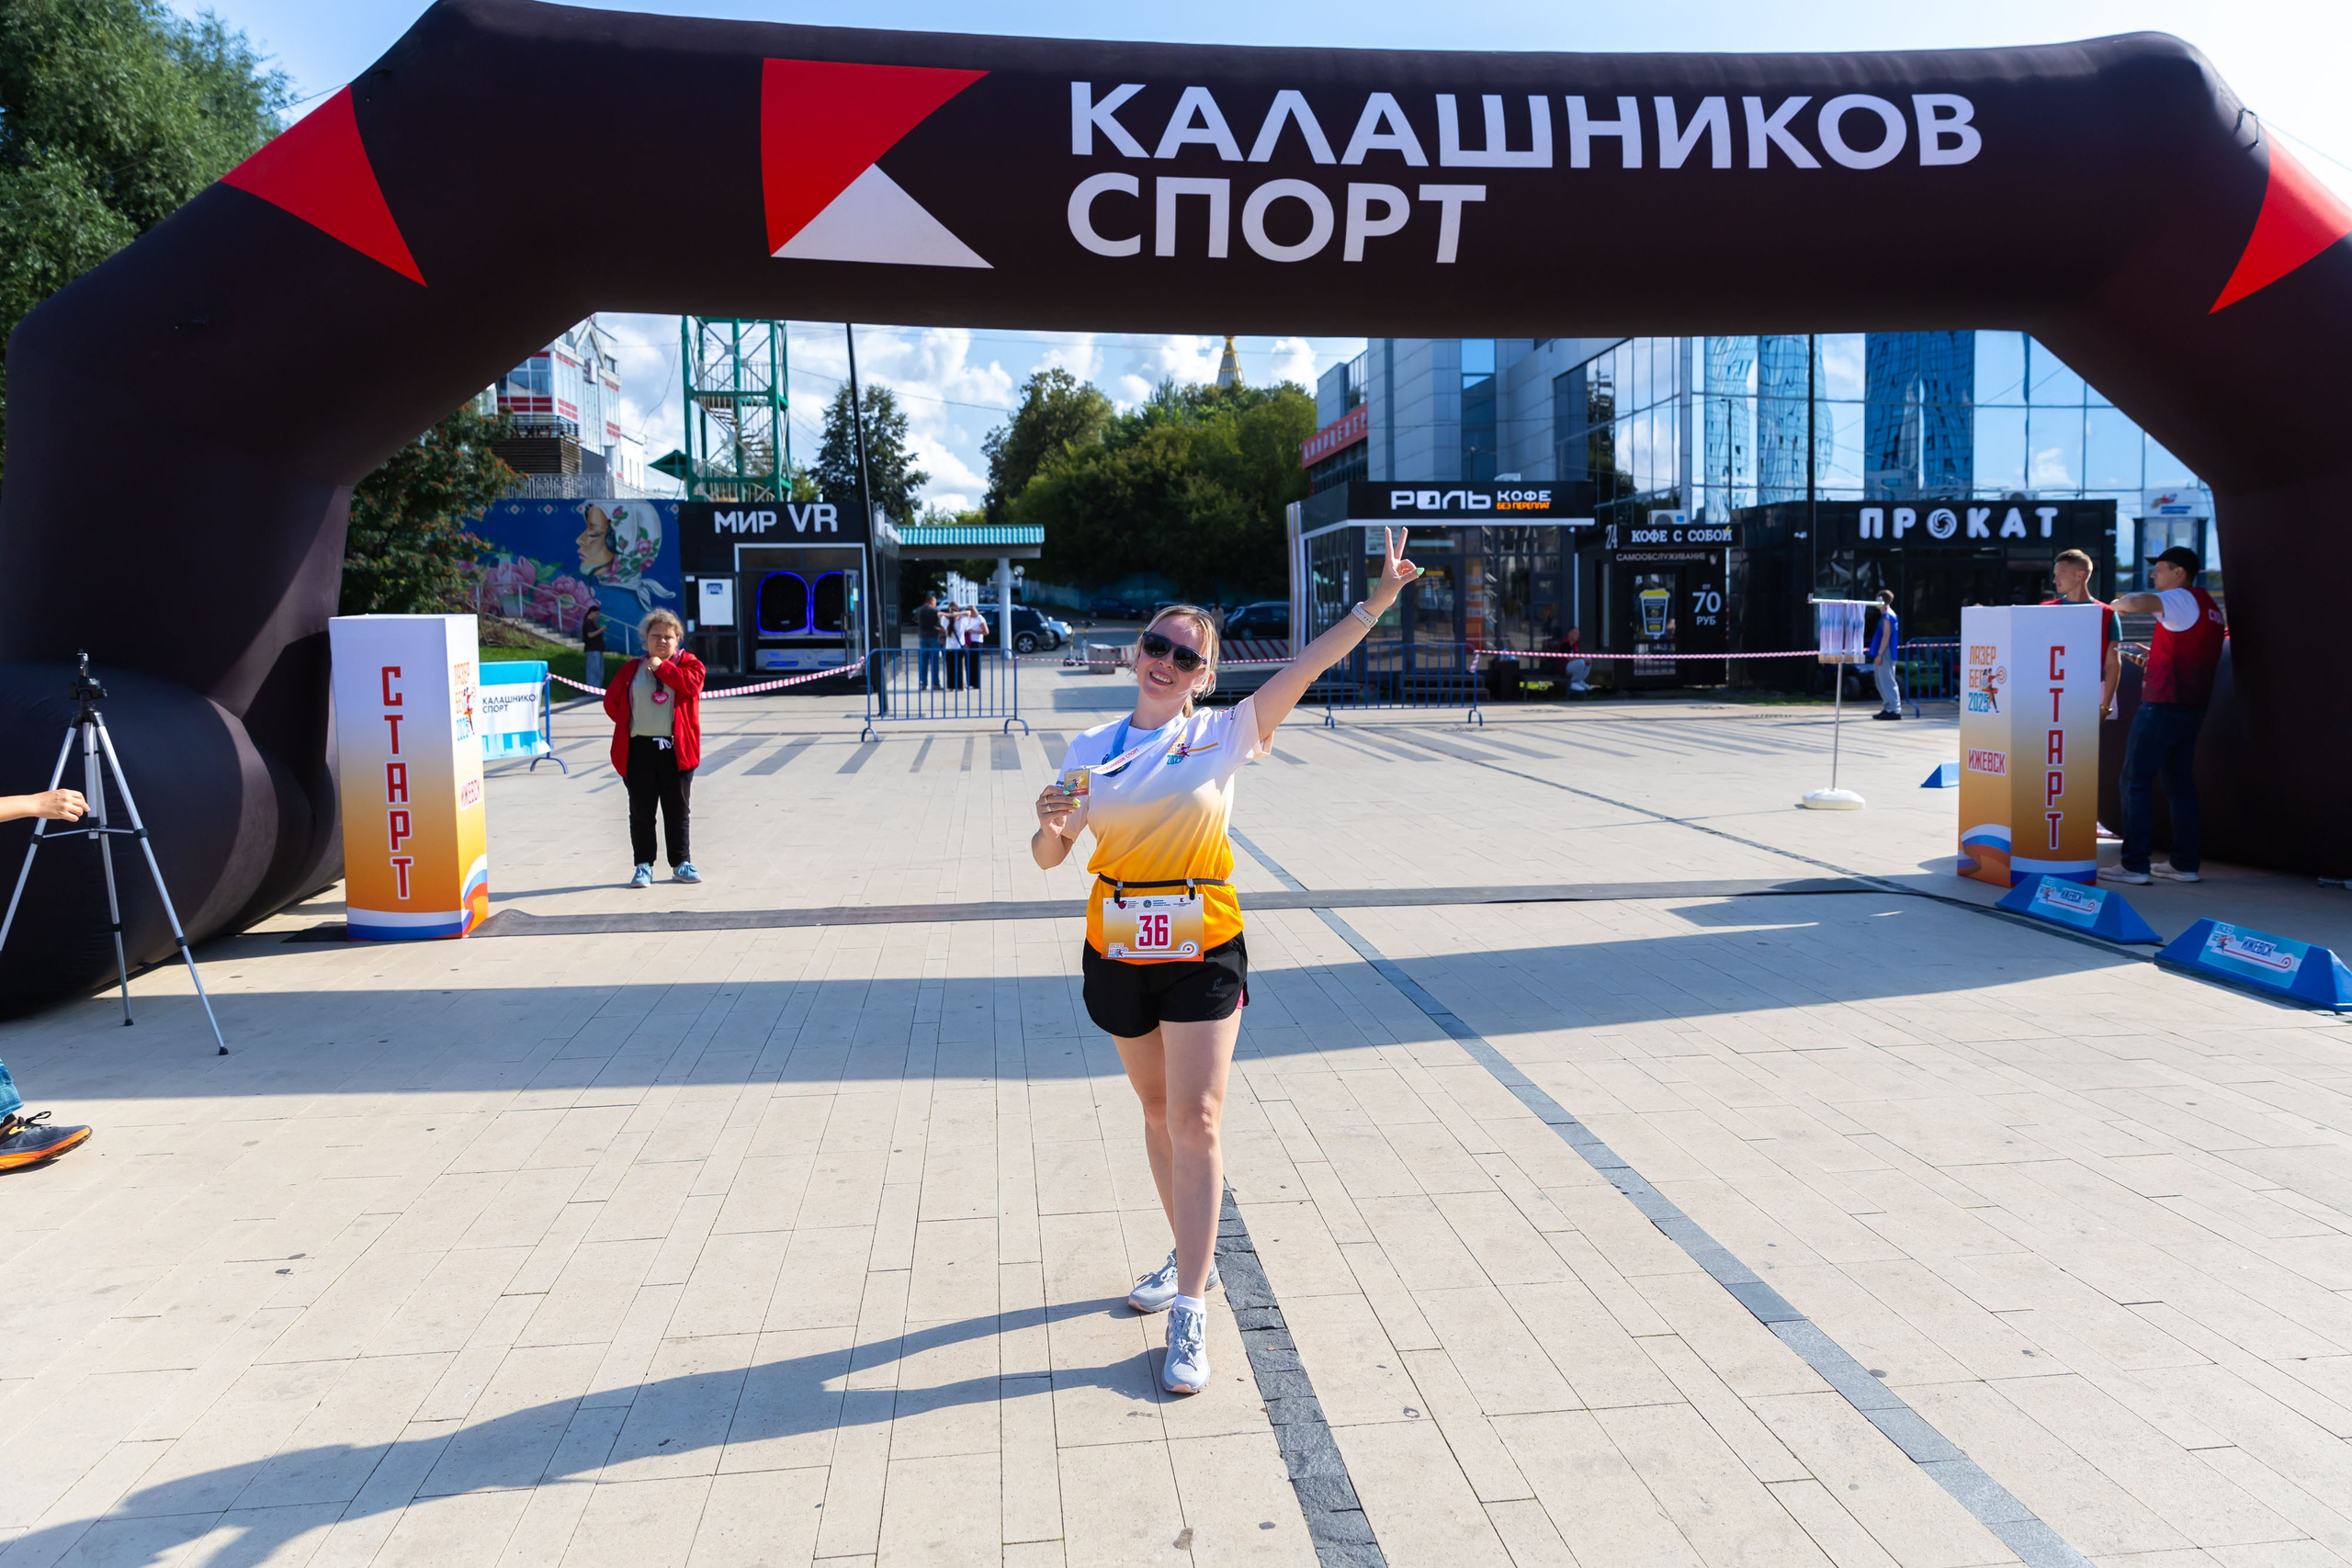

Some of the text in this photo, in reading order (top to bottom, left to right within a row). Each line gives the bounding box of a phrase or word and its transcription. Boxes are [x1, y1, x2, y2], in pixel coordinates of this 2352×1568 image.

[1070, 81, 1983, 171] КАЛАШНИКОВ
[1067, 172, 1487, 264] СПОРТ
[1391, 490, 1492, 510] РОЛЬ
[1497, 490, 1552, 502] КОФЕ
[1497, 502, 1550, 510] БЕЗ ПЕРЕПЛАТ
[714, 503, 838, 534] МИР VR
[1859, 507, 2059, 539] ПРОКАТ
[1631, 527, 1733, 543] КОФЕ С СОБОЙ
[1692, 592, 1722, 613] 70
[1696, 616, 1716, 626] РУБ
[1969, 646, 1996, 665] ЛАЗЕР
[482, 705, 508, 714] СПОРТ
[1968, 692, 1990, 712] 2025
[2047, 646, 2065, 848] СТАРТ
[1968, 749, 2006, 774] ИЖЕВСК
[381, 666, 412, 898] СТАРТ
[1139, 914, 1169, 947] 36
